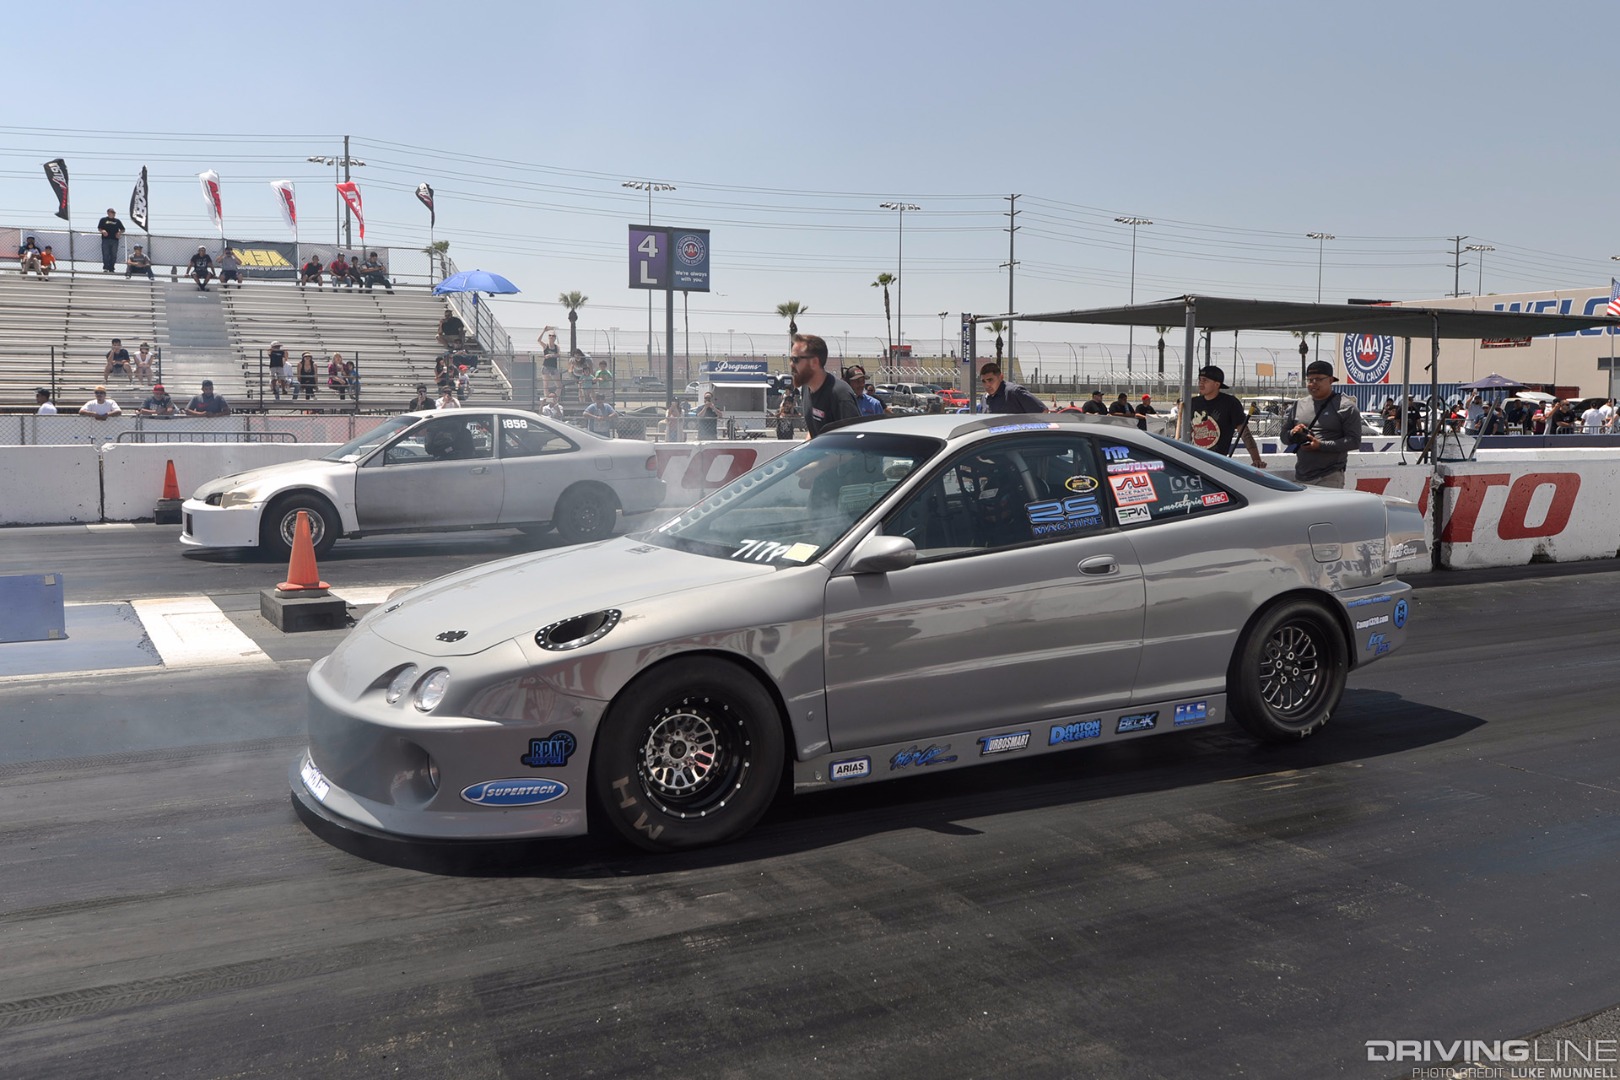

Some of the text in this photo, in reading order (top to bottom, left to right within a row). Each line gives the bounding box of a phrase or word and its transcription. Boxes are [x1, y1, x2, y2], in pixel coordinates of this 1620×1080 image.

[638, 235, 658, 258] 4
[684, 244, 698, 254] AAA
[640, 260, 658, 284] L
[1357, 336, 1379, 356] AAA
[714, 361, 762, 372] Programs
[1344, 344, 1392, 382] SOUTHERN CALIFORNIA
[1171, 475, 1202, 490] OG
[1204, 493, 1226, 505] MoTeC
[1118, 505, 1148, 518] SPW
[1033, 516, 1104, 535] MACHINE
[978, 731, 1031, 753] TURBOSMART
[1064, 730, 1101, 741] SLEEVES
[532, 740, 565, 764] RPM
[836, 762, 865, 775] ARIAS
[486, 784, 557, 798] SUPERTECH
